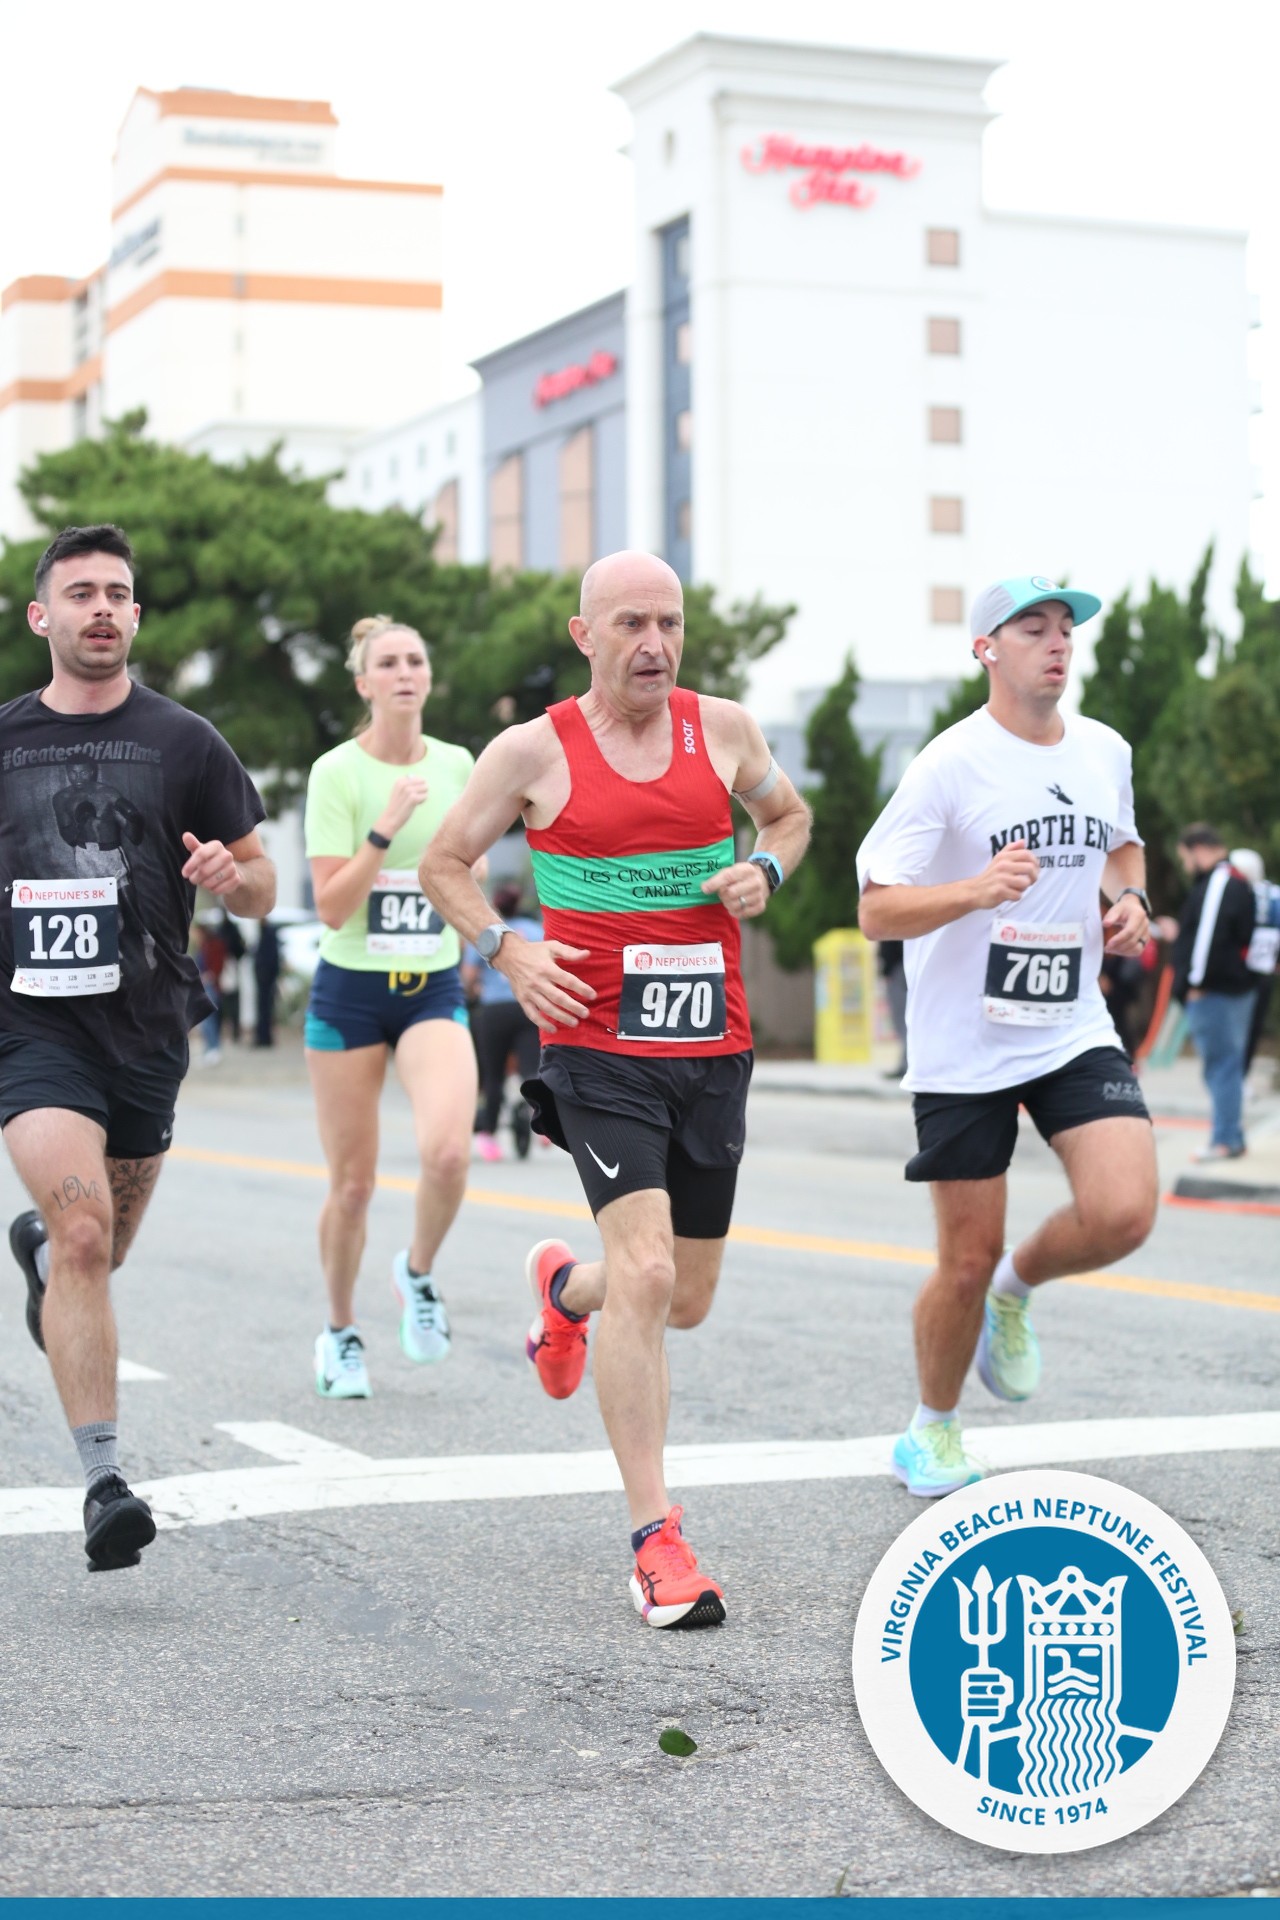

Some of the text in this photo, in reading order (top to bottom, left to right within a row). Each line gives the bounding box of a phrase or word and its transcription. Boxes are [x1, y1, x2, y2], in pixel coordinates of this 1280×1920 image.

[682, 719, 696, 754] soar
[3, 740, 162, 770] #GreatestOfAllTime
[990, 814, 1075, 857] NORTH
[583, 870, 610, 883] LES
[618, 862, 701, 882] CROUPIERS
[1037, 854, 1085, 868] UN CLUB
[92, 890, 105, 899] 8K
[632, 882, 692, 899] CARDIFF
[381, 894, 433, 931] 947
[29, 914, 99, 960] 128
[1002, 952, 1070, 996] 766
[641, 981, 712, 1029] 970
[52, 1176, 105, 1211] LOVE
